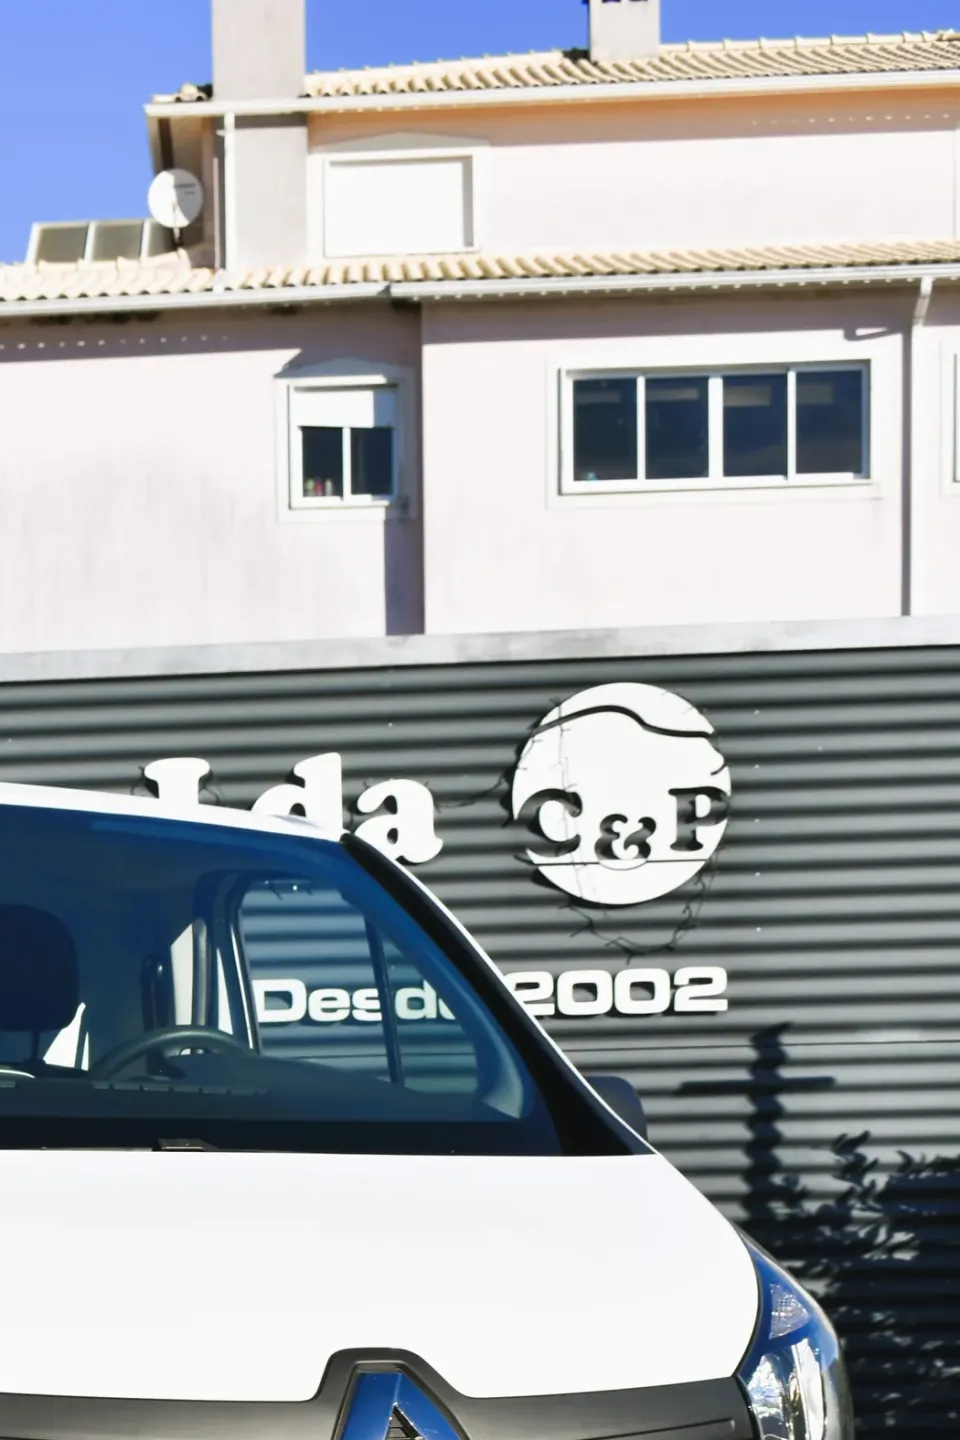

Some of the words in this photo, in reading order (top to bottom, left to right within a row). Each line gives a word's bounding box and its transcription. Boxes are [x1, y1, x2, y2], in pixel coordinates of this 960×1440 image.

[515, 786, 730, 860] C&P
[252, 979, 456, 1022] Desd
[504, 966, 728, 1016] 2002
